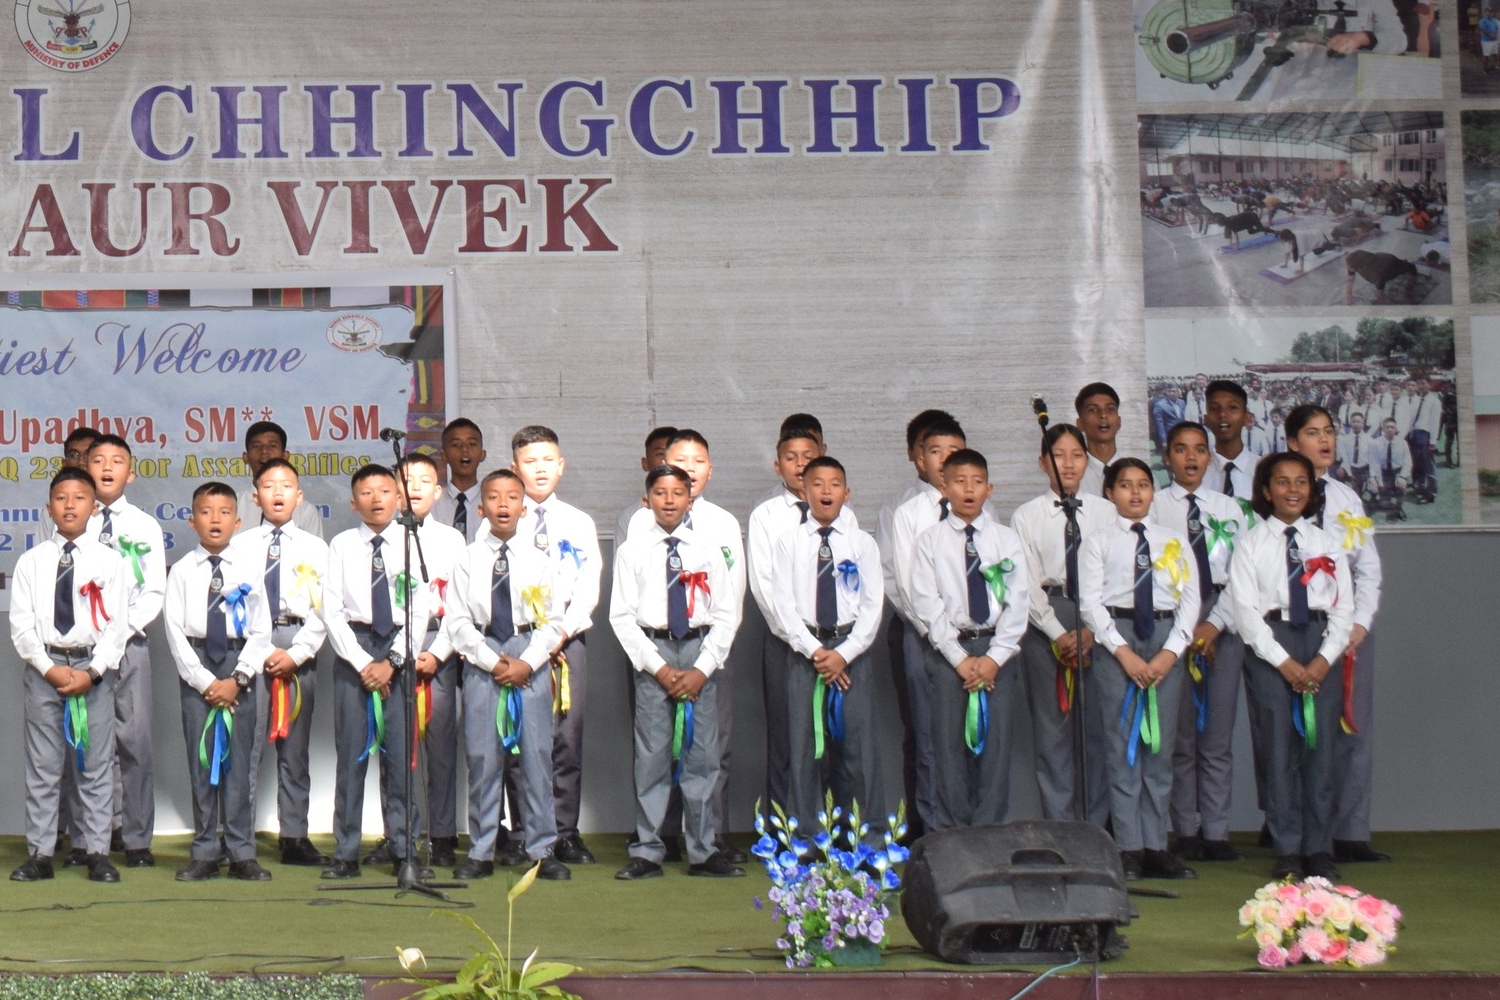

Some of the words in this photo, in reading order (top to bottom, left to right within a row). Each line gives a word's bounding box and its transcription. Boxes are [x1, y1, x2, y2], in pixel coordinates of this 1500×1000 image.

[24, 40, 65, 69] MINISTRY
[67, 60, 81, 69] OF
[83, 41, 120, 68] DEFENCE
[130, 76, 1021, 161] CHHINGCHHIP
[8, 181, 241, 259] AUR
[266, 177, 620, 255] VIVEK
[95, 321, 308, 375] Welcome
[304, 404, 380, 442] VSM
[182, 454, 253, 478] Assa
